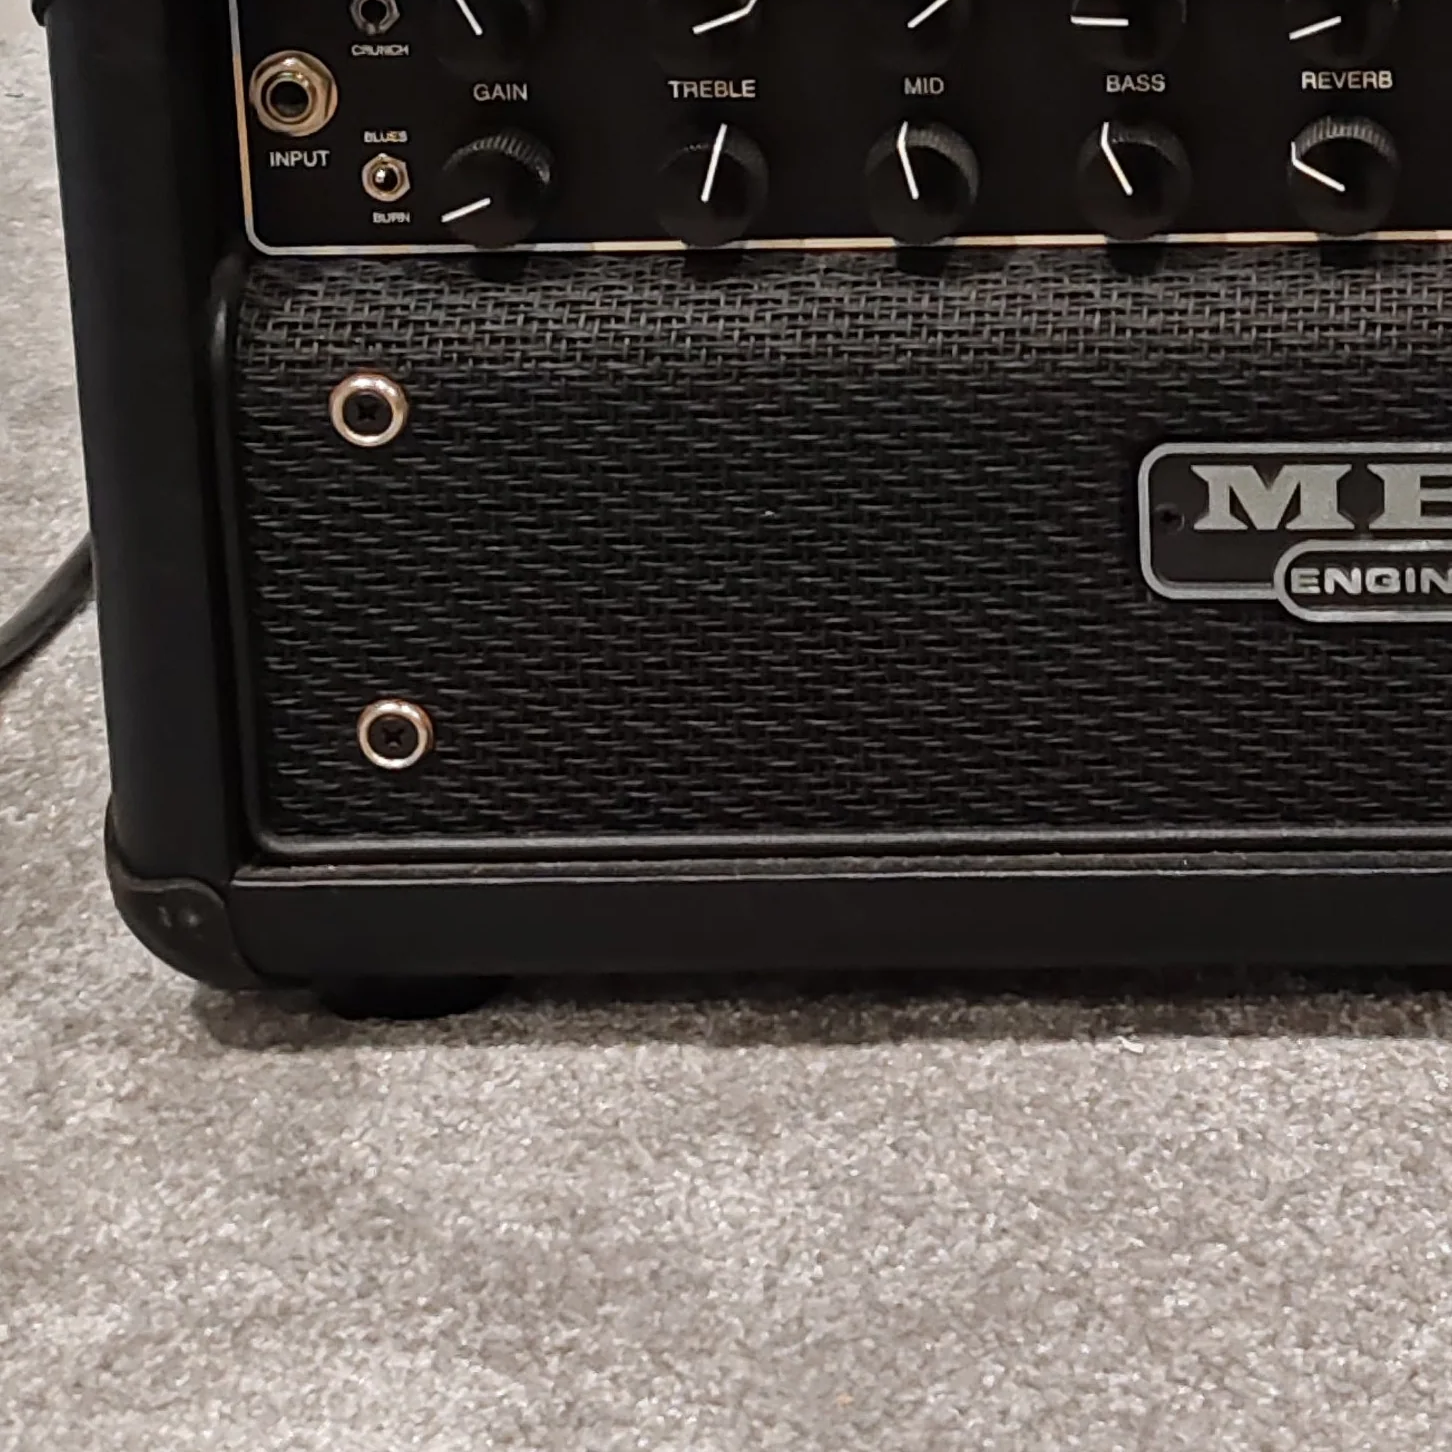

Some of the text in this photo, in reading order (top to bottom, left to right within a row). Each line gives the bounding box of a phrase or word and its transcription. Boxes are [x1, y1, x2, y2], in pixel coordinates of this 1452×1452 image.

[351, 44, 409, 56] CRUNCH
[668, 79, 757, 99] TREBLE
[904, 77, 944, 95] MID
[1106, 74, 1166, 93] BASS
[1301, 70, 1394, 90] REVERB
[473, 83, 528, 102] GAIN
[364, 131, 408, 143] BLUES
[269, 150, 330, 168] INPUT
[372, 212, 410, 224] BURN
